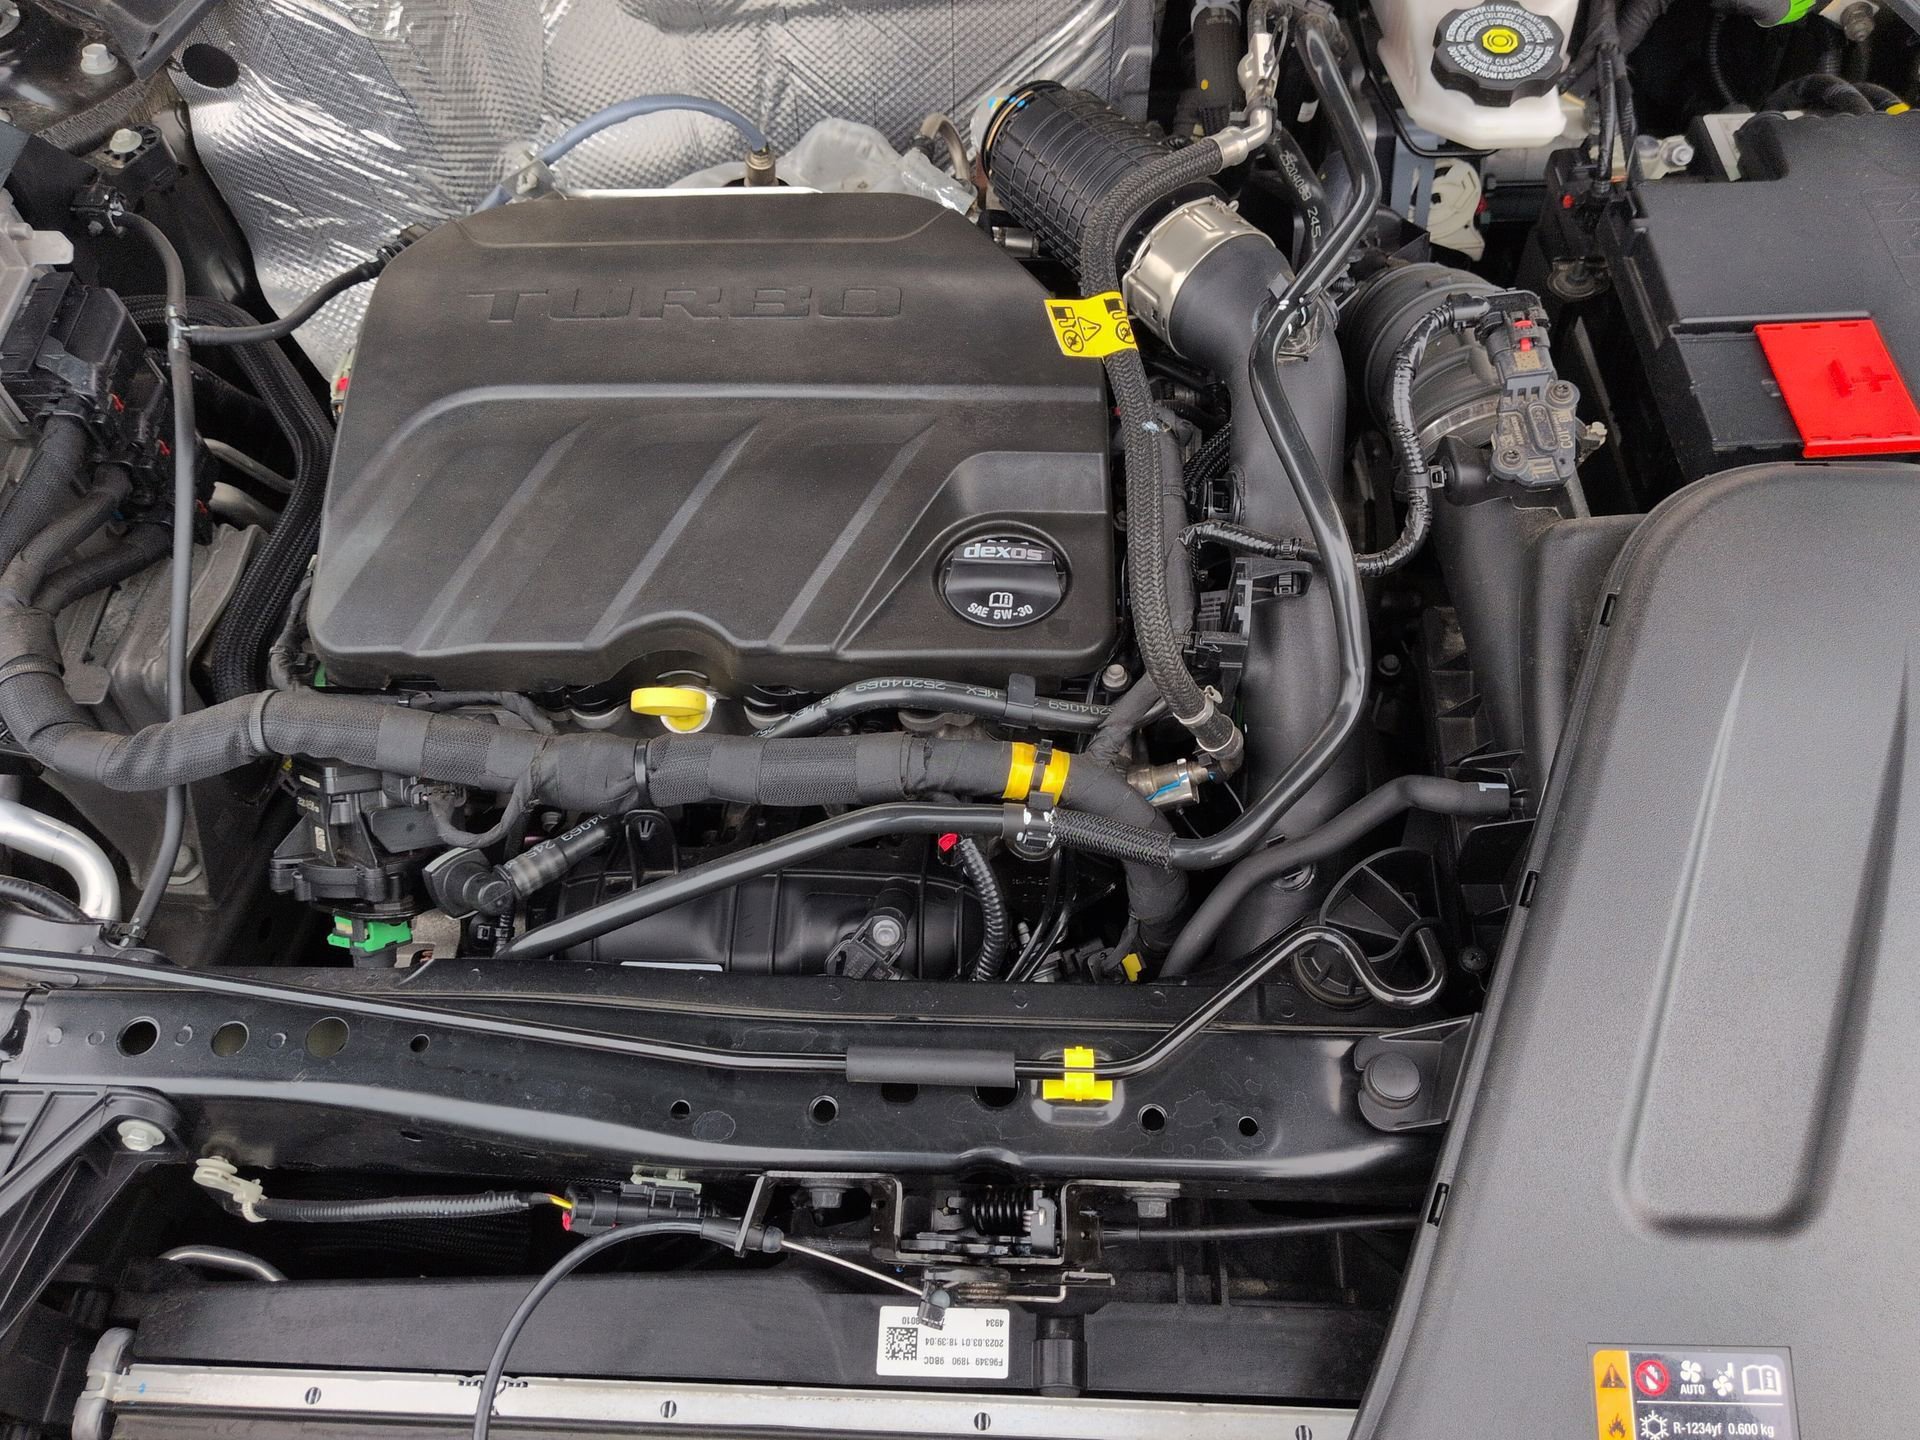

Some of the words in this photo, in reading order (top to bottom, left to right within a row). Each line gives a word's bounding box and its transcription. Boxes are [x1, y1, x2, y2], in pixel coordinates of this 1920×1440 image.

[1475, 69, 1497, 80] FROM
[467, 287, 903, 324] TURBO
[963, 542, 1046, 561] dexos
[967, 602, 990, 618] SAE
[993, 604, 1034, 620] 5W-30
[855, 677, 946, 692] 25204069
[966, 685, 999, 699] MEX
[985, 1318, 1005, 1328] 4934
[924, 1337, 958, 1346] 18:39:04
[960, 1337, 1005, 1348] 2023.03.01
[951, 1357, 970, 1366] 1890
[1680, 1383, 1705, 1395] AUTO
[1672, 1421, 1722, 1436] R-1234yf
[1728, 1422, 1758, 1436] 0.600
[1760, 1423, 1775, 1438] kg
